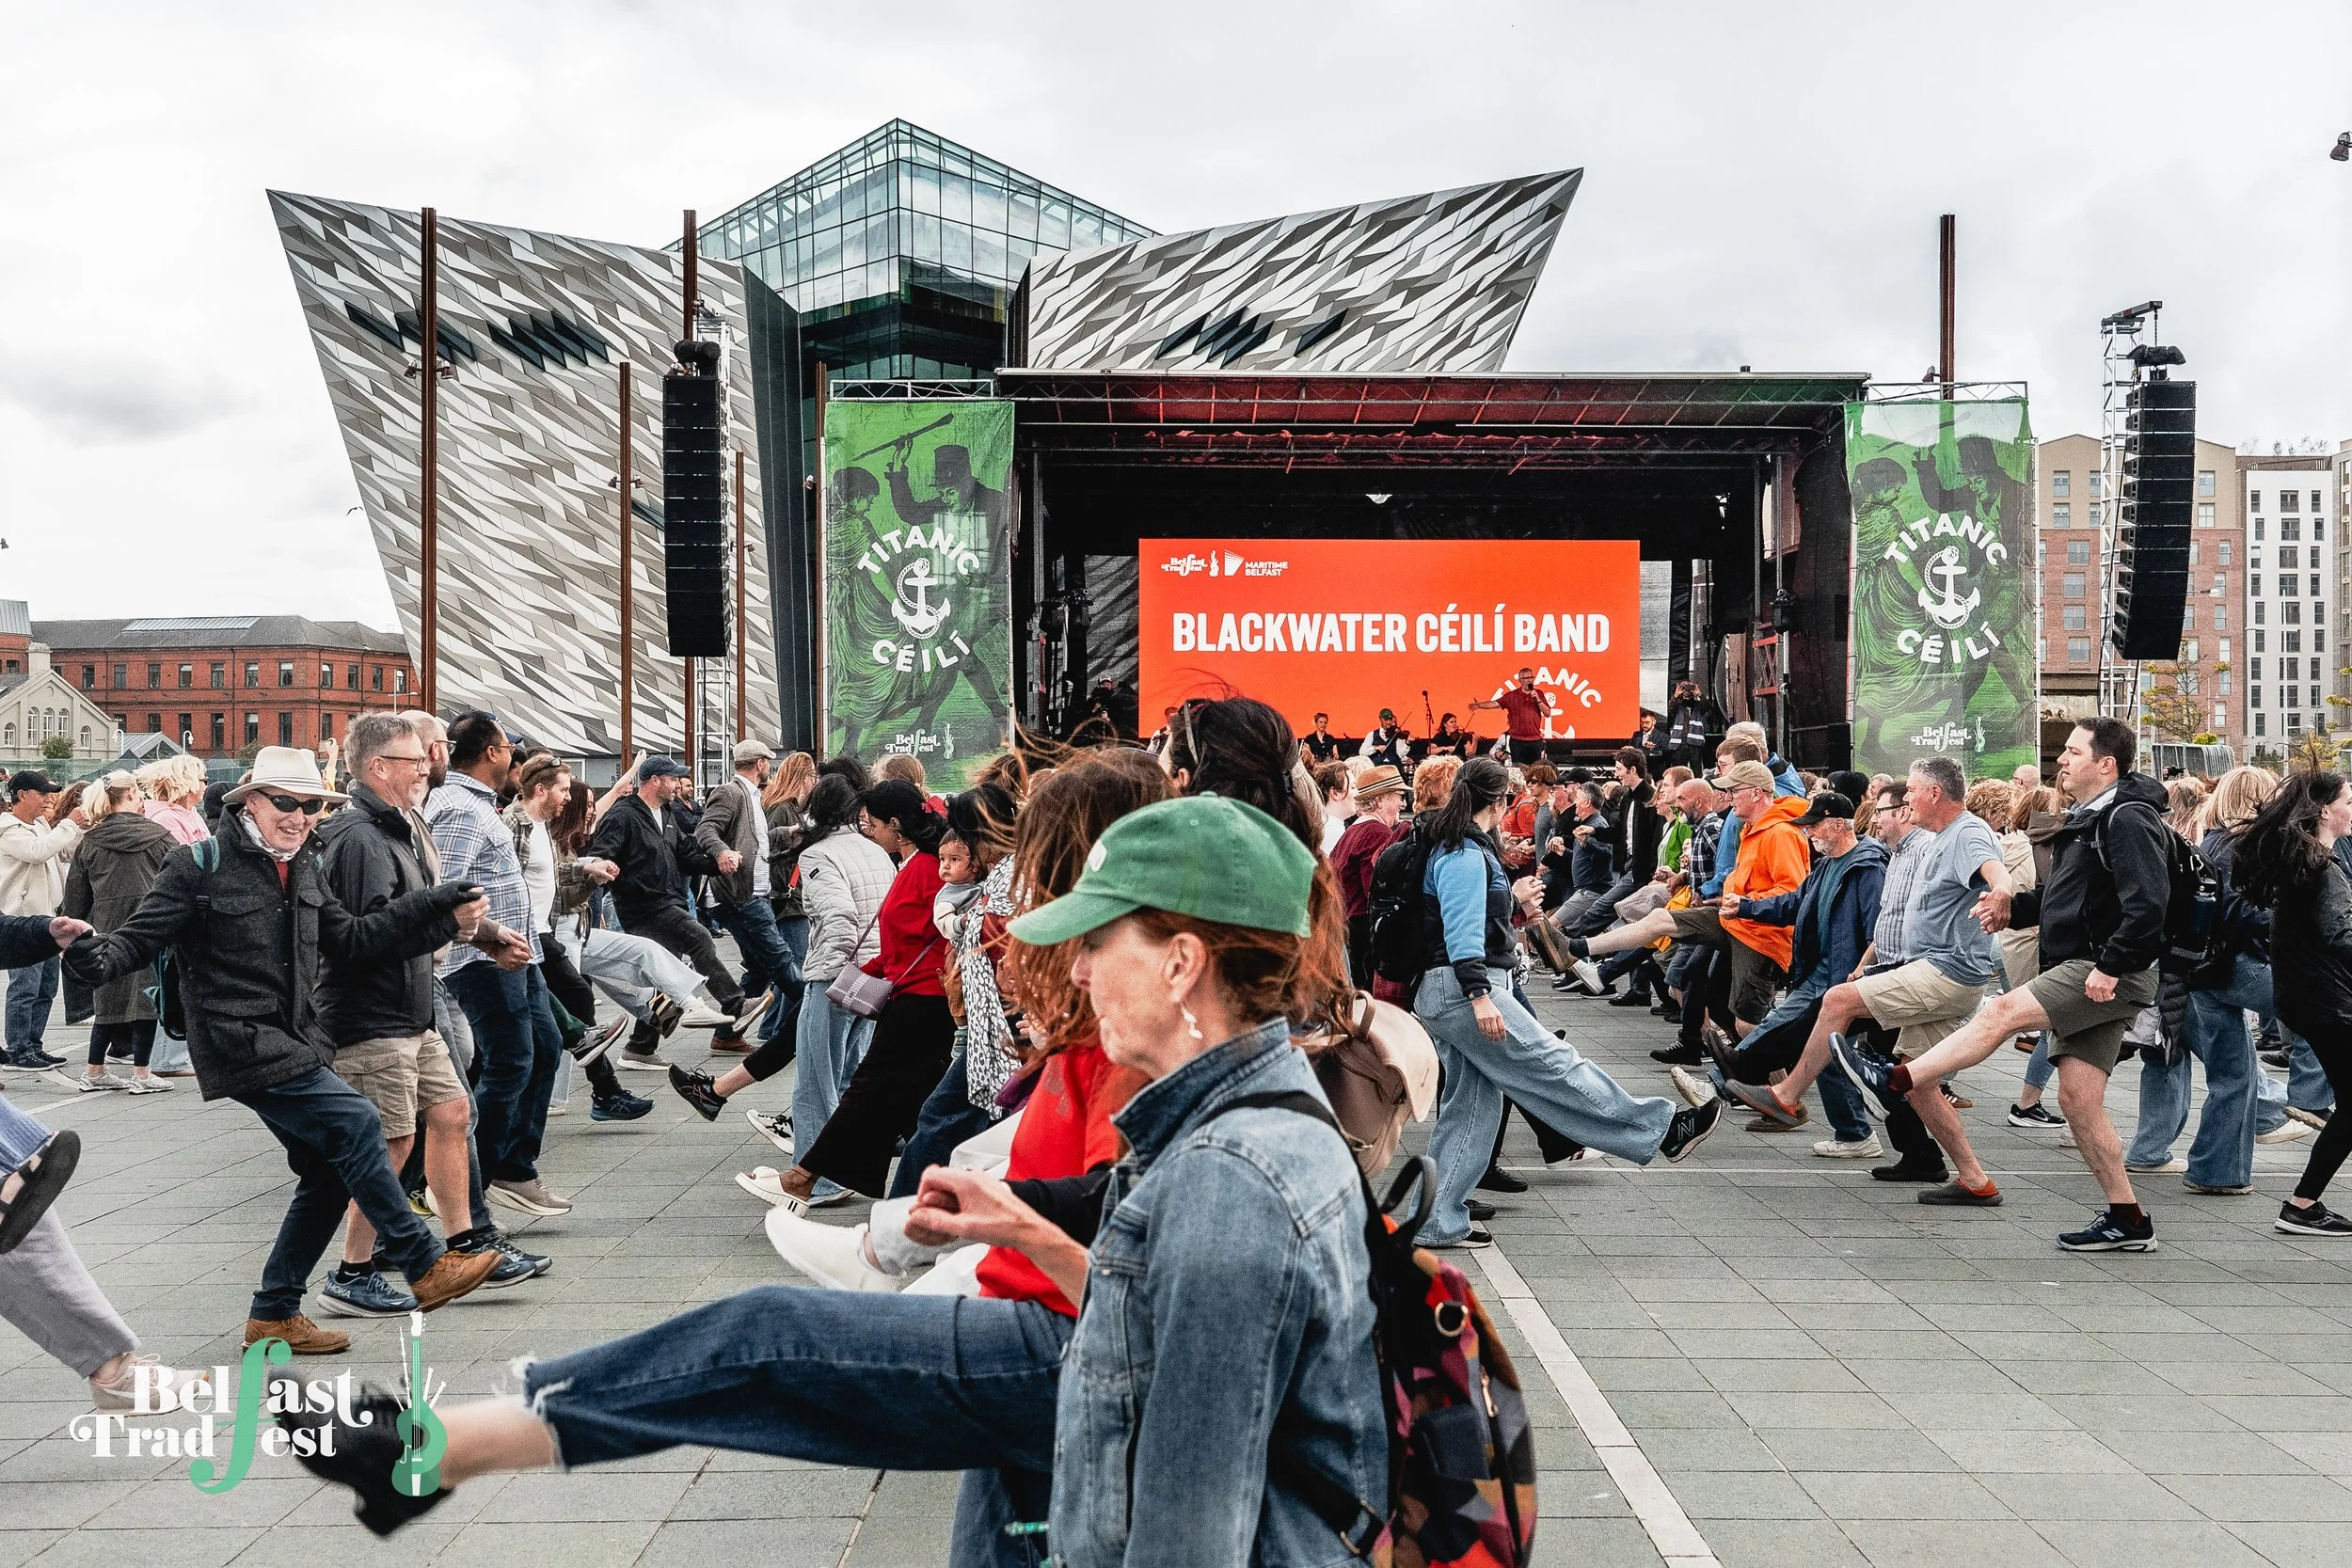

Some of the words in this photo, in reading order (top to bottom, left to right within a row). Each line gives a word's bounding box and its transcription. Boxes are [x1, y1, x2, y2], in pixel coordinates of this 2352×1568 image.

[856, 525, 980, 576] TITANIC
[1883, 513, 2008, 566] TITANIC
[1172, 612, 1407, 653] BLACKWATER
[1415, 603, 1505, 653] CÉILÍ
[1514, 613, 1610, 653] BAND
[1897, 621, 2001, 664] CÉILÍ
[872, 629, 971, 673] CÉILÍ
[1490, 666, 1602, 708] TIANIC
[895, 729, 941, 747] Belfast
[1923, 721, 1972, 740] Belfast
[327, 1282, 351, 1298] HOKA
